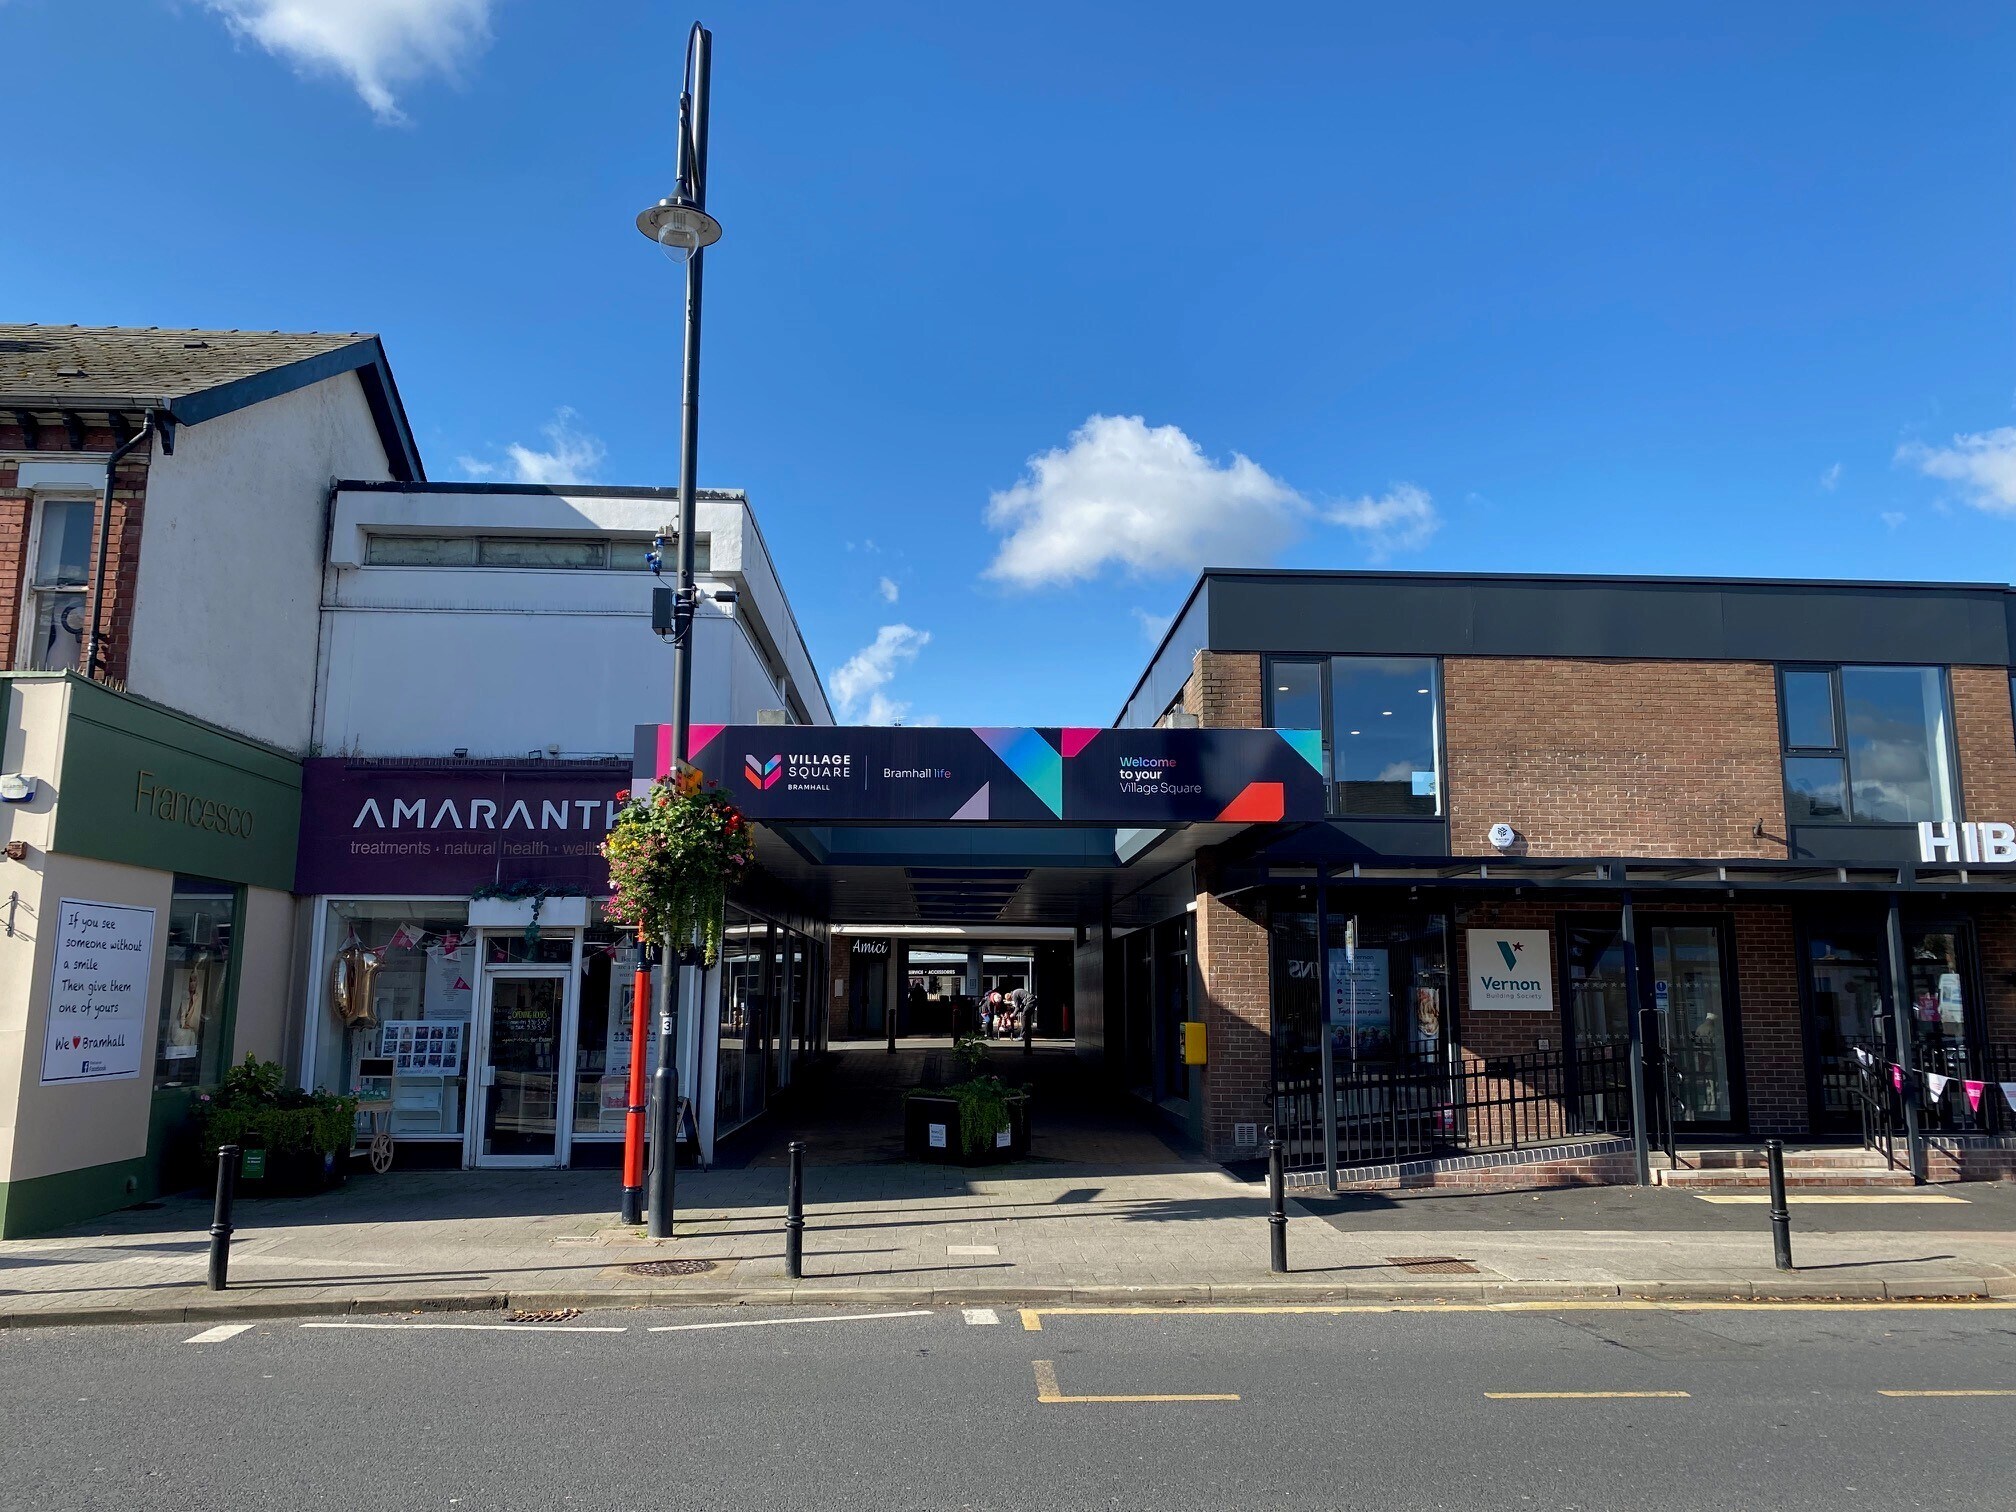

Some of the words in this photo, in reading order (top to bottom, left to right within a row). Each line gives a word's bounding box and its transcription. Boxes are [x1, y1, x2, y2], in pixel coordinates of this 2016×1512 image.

[788, 754, 851, 765] VILLAGE
[1119, 756, 1177, 768] Welcome
[788, 766, 851, 779] SQUARE
[883, 767, 932, 779] Bramhall
[933, 767, 951, 779] life
[1119, 769, 1133, 780] to
[1134, 770, 1163, 783] your
[787, 783, 831, 791] BRAMHALL
[1119, 782, 1159, 796] Village
[1160, 782, 1202, 796] Square
[135, 770, 254, 839] Francesco
[350, 840, 432, 856] treatments
[444, 840, 497, 856] natural
[502, 840, 550, 856] health
[562, 840, 601, 856] wellb
[1917, 820, 2016, 863] HIB
[68, 911, 80, 929] If
[81, 918, 99, 934] you
[101, 919, 116, 930] see
[65, 938, 107, 950] someone
[110, 939, 142, 952] without
[852, 938, 888, 954] Amici
[63, 960, 69, 969] a
[73, 958, 98, 970] smile
[61, 979, 84, 992] Then
[88, 980, 107, 996] give
[110, 980, 132, 992] them
[1480, 976, 1542, 991] Vernon
[58, 1003, 77, 1014] one
[80, 998, 93, 1017] of
[94, 1003, 119, 1020] yours
[663, 1020, 671, 1031] 3
[55, 1037, 70, 1051] We
[82, 1034, 126, 1050] Bramhall
